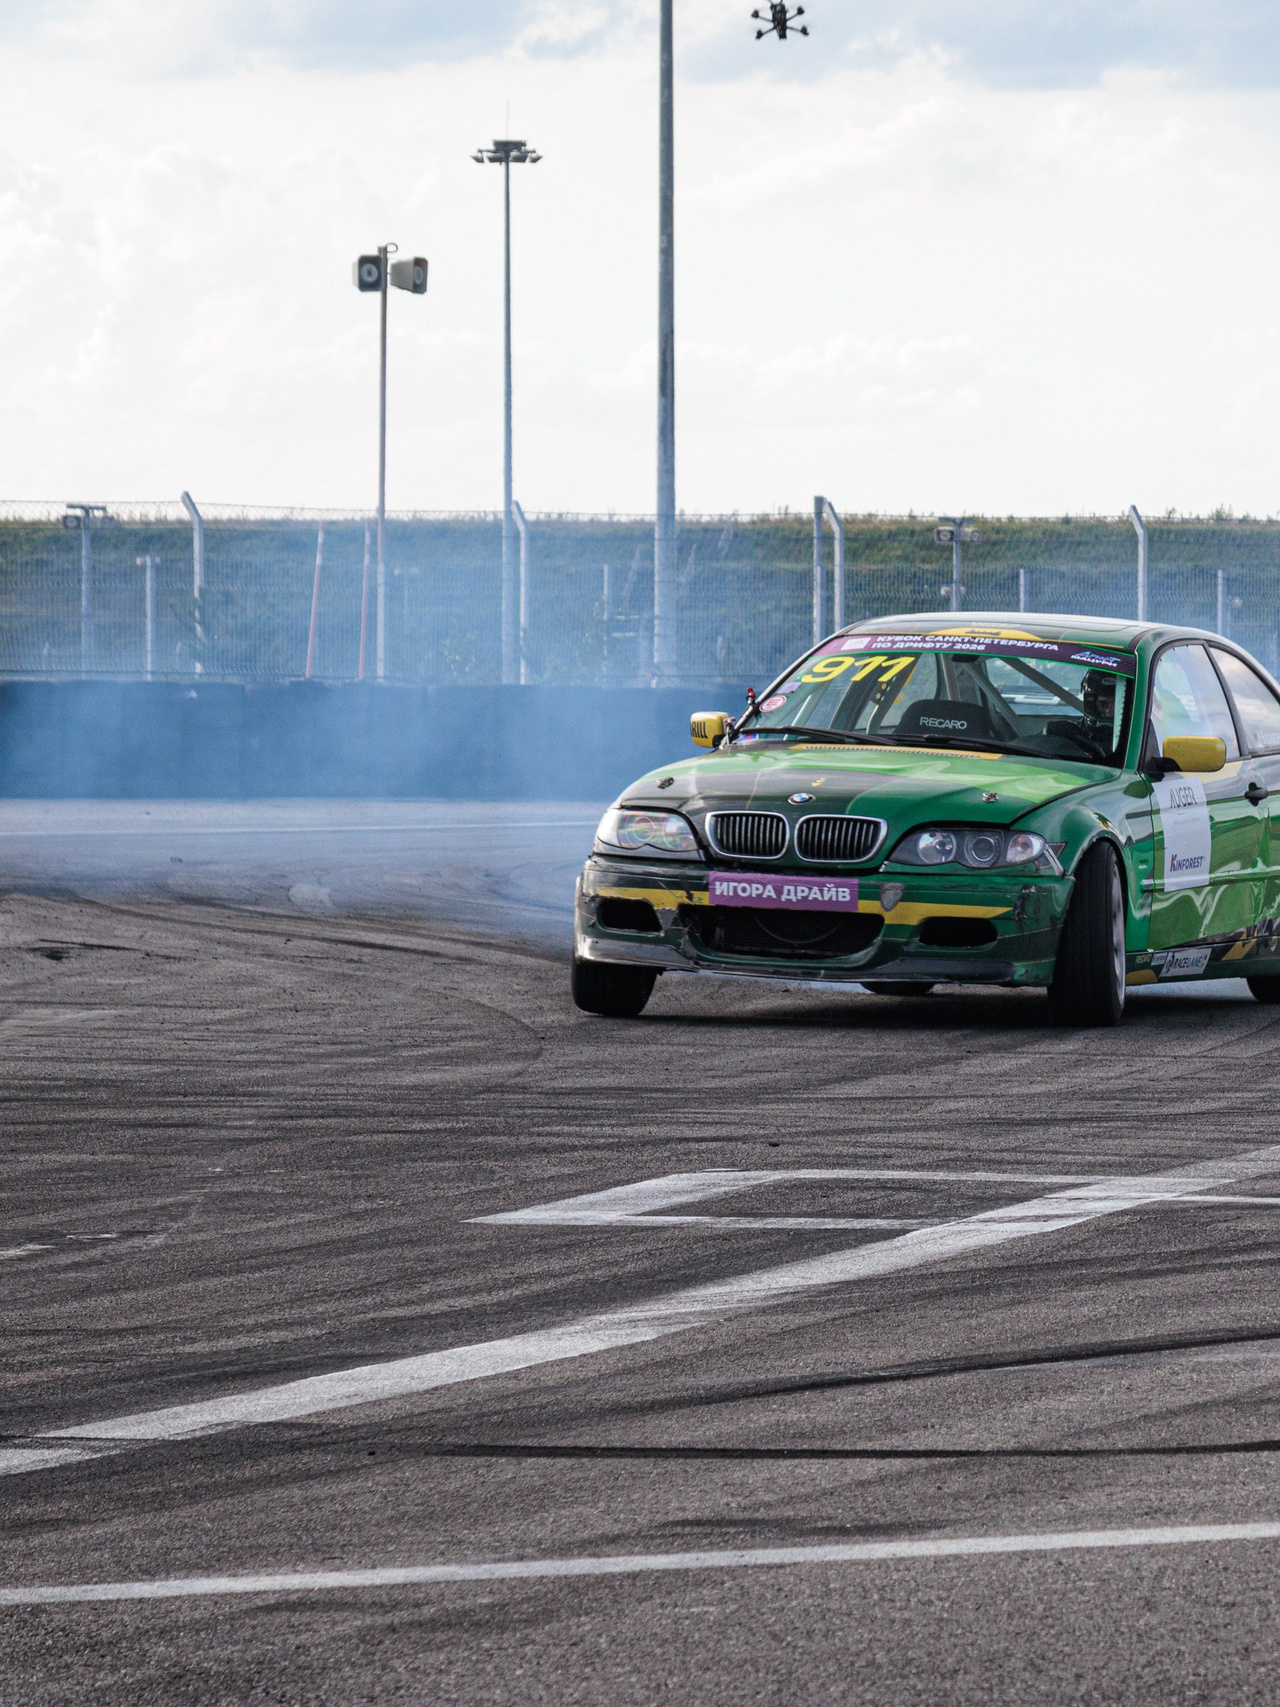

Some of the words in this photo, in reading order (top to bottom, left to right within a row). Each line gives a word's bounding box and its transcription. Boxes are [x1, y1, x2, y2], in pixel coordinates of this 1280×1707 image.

[925, 635, 1058, 651] САНКТ-ПЕТЕРБУРГА
[953, 643, 986, 651] 2026
[801, 656, 915, 684] 911
[920, 716, 967, 729] RECARO
[1170, 786, 1198, 809] AUGER
[1170, 853, 1204, 872] KINFOREST
[714, 881, 777, 899] ИГОРА
[780, 883, 851, 902] ДРАЙВ
